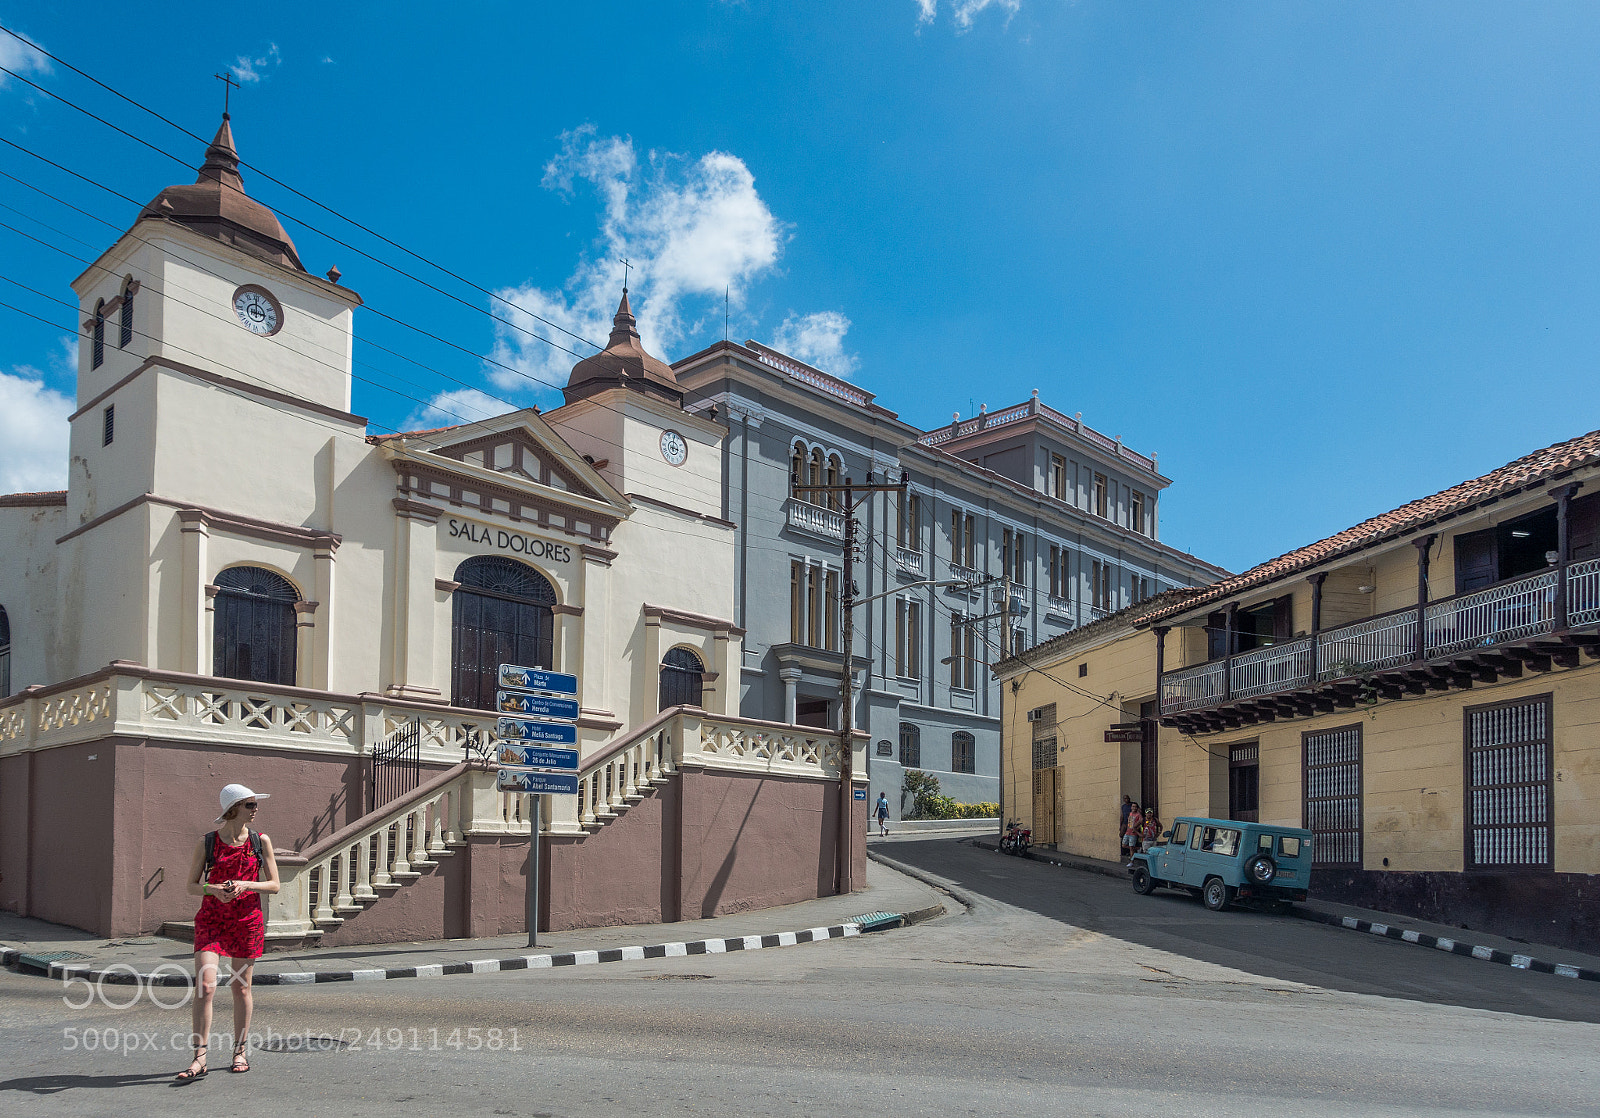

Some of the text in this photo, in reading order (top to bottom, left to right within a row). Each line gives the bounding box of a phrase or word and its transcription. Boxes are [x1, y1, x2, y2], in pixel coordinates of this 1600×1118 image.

[449, 519, 571, 563] SALA DOLORES
[531, 705, 549, 713] Heredia
[545, 732, 564, 741] Santiago
